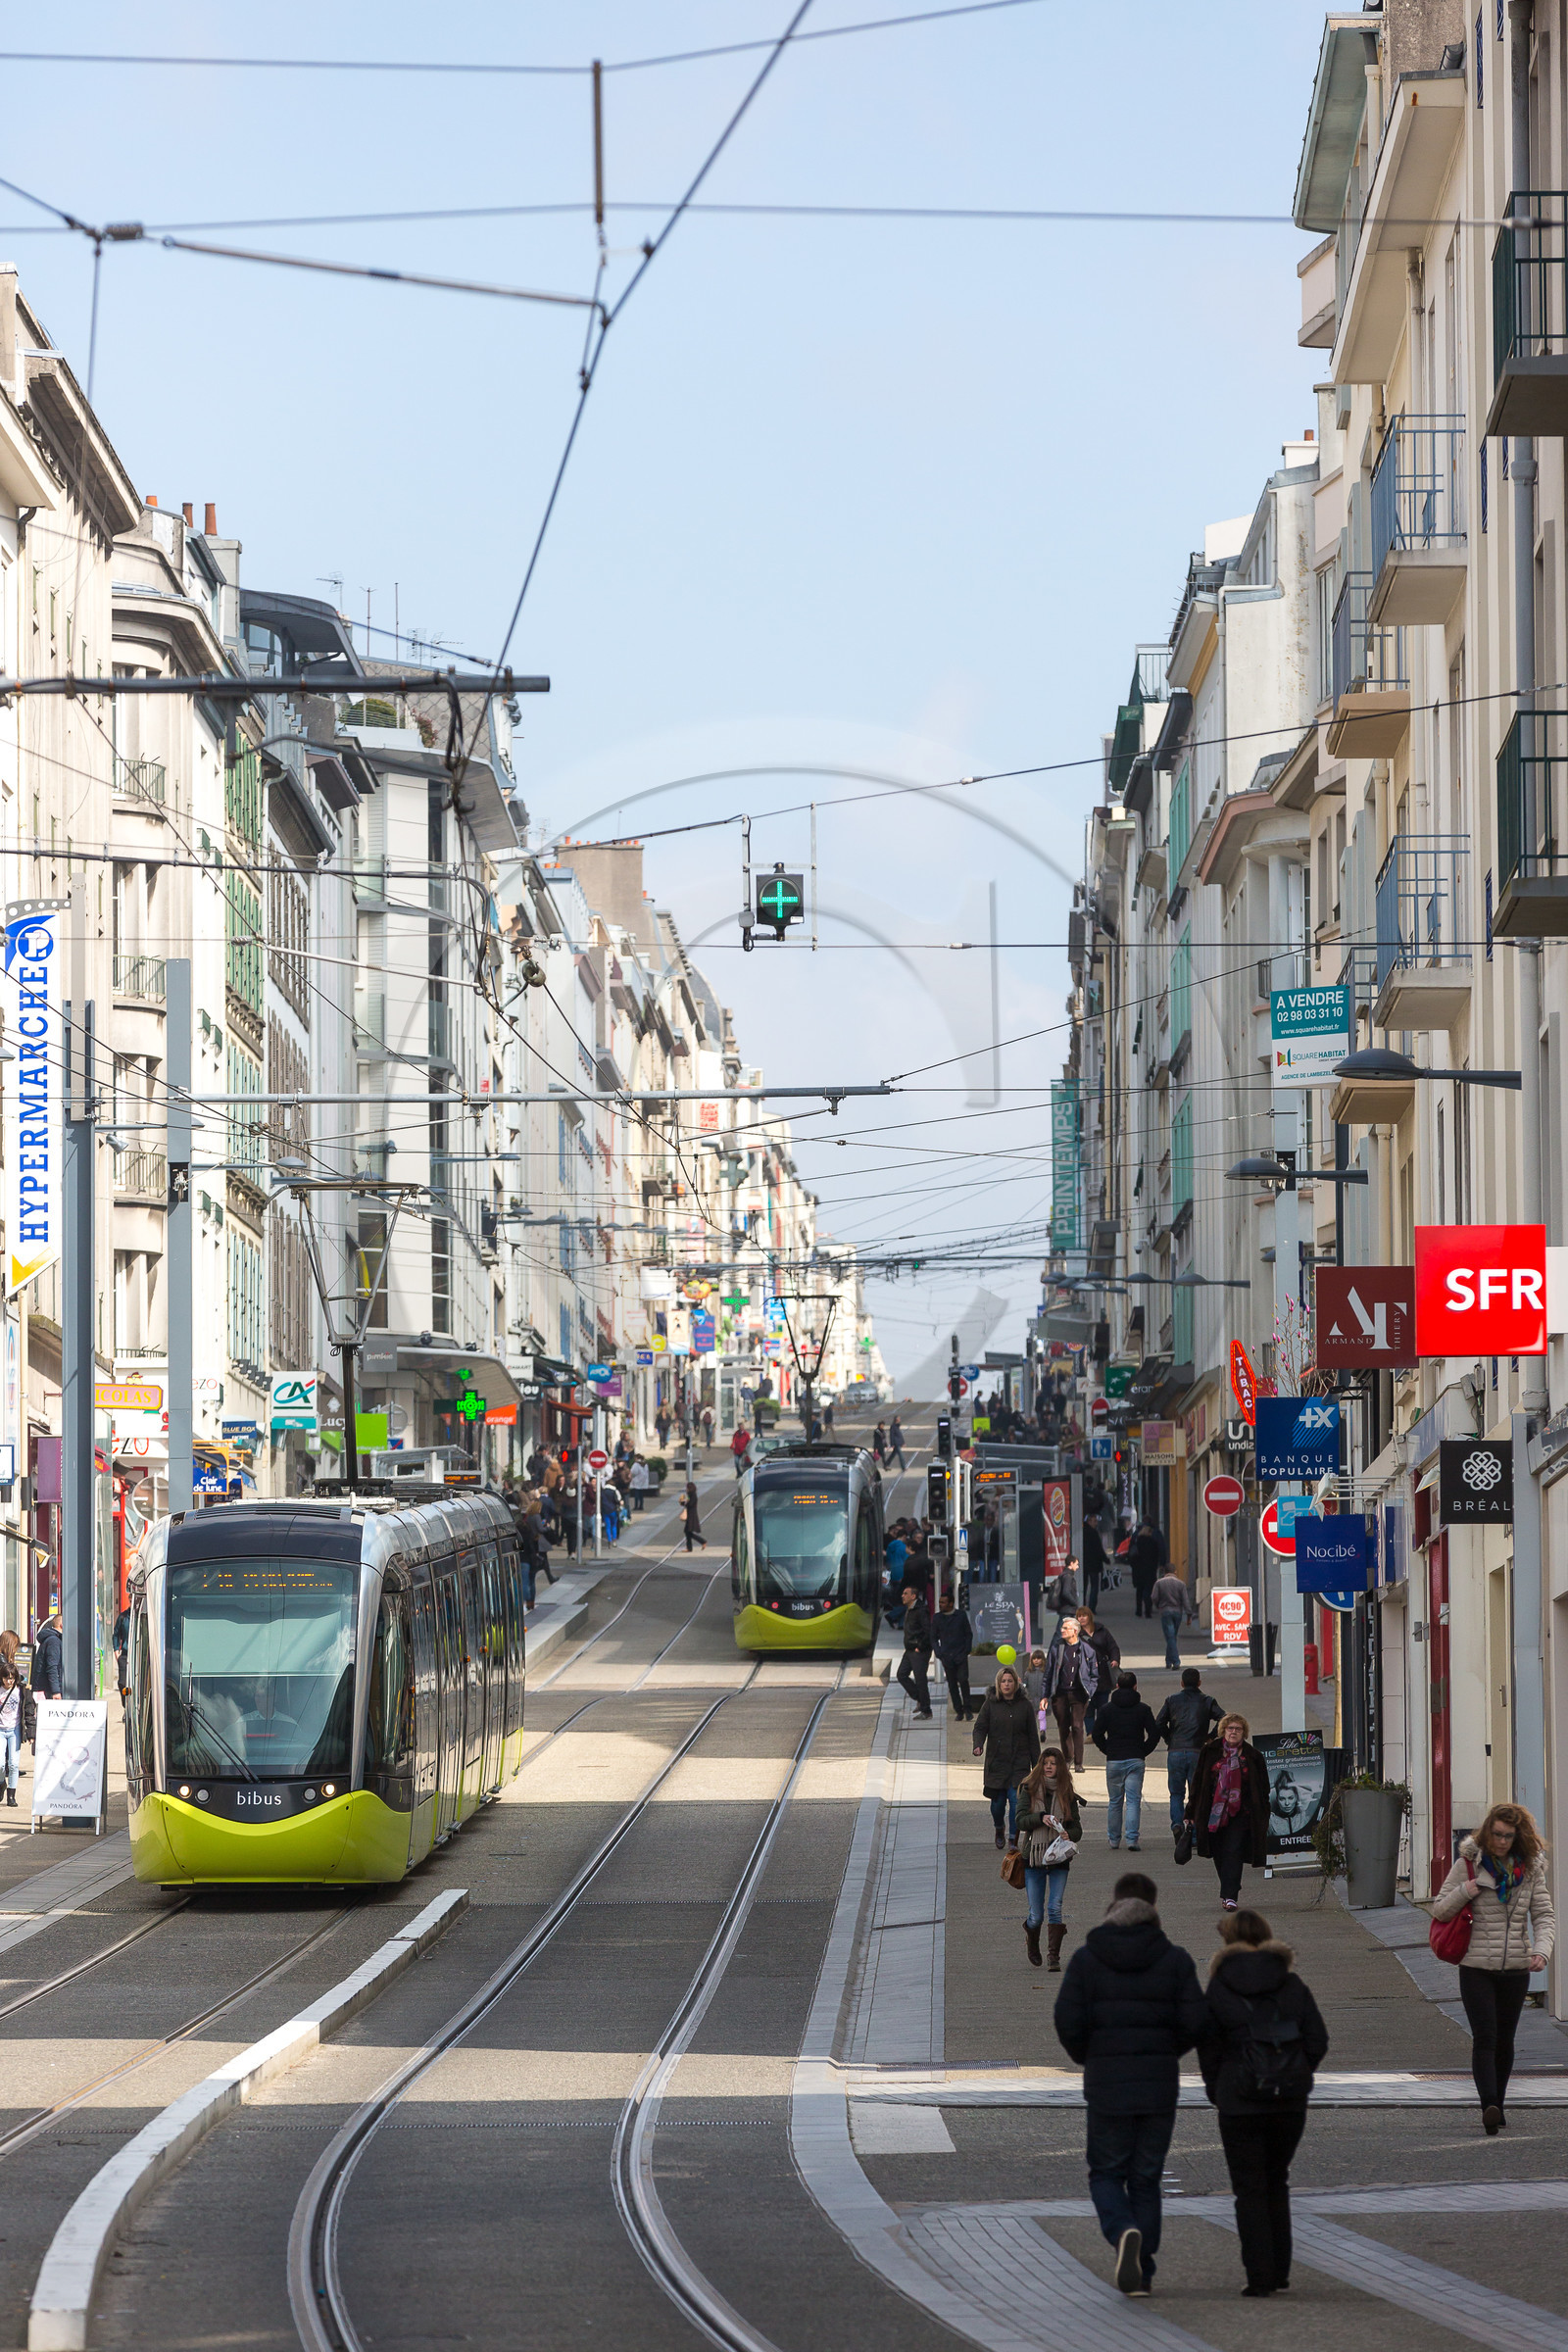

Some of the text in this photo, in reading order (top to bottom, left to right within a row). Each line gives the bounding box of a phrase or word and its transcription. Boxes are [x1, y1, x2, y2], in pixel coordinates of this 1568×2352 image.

[1277, 991, 1345, 1009] A VENDRE
[1277, 1006, 1343, 1022] 02 98 03 31 10
[1281, 1024, 1340, 1035] www.squarehabitat.fr
[19, 966, 49, 1243] HYPERMARCHE
[1054, 1100, 1074, 1236] PRINTEMPS
[1446, 1268, 1544, 1311] SFR
[1236, 1356, 1252, 1408] TABAC
[1261, 1454, 1334, 1463] BANQUE
[1261, 1466, 1334, 1476] POPULAIRE
[200, 1476, 218, 1485] Clair
[193, 1483, 222, 1493] de lune
[1453, 1498, 1511, 1511] BRÉAL
[1306, 1544, 1356, 1559] Nocibé
[791, 1602, 814, 1611] bibus
[1223, 1632, 1242, 1641] RDV
[48, 1710, 95, 1719] PANDORA
[1278, 1738, 1299, 1749] Like
[1285, 1755, 1321, 1764] gratuitement
[1289, 1760, 1322, 1770] électronique
[236, 1790, 282, 1806] bibus
[1280, 1835, 1312, 1846] ENTRÉE
